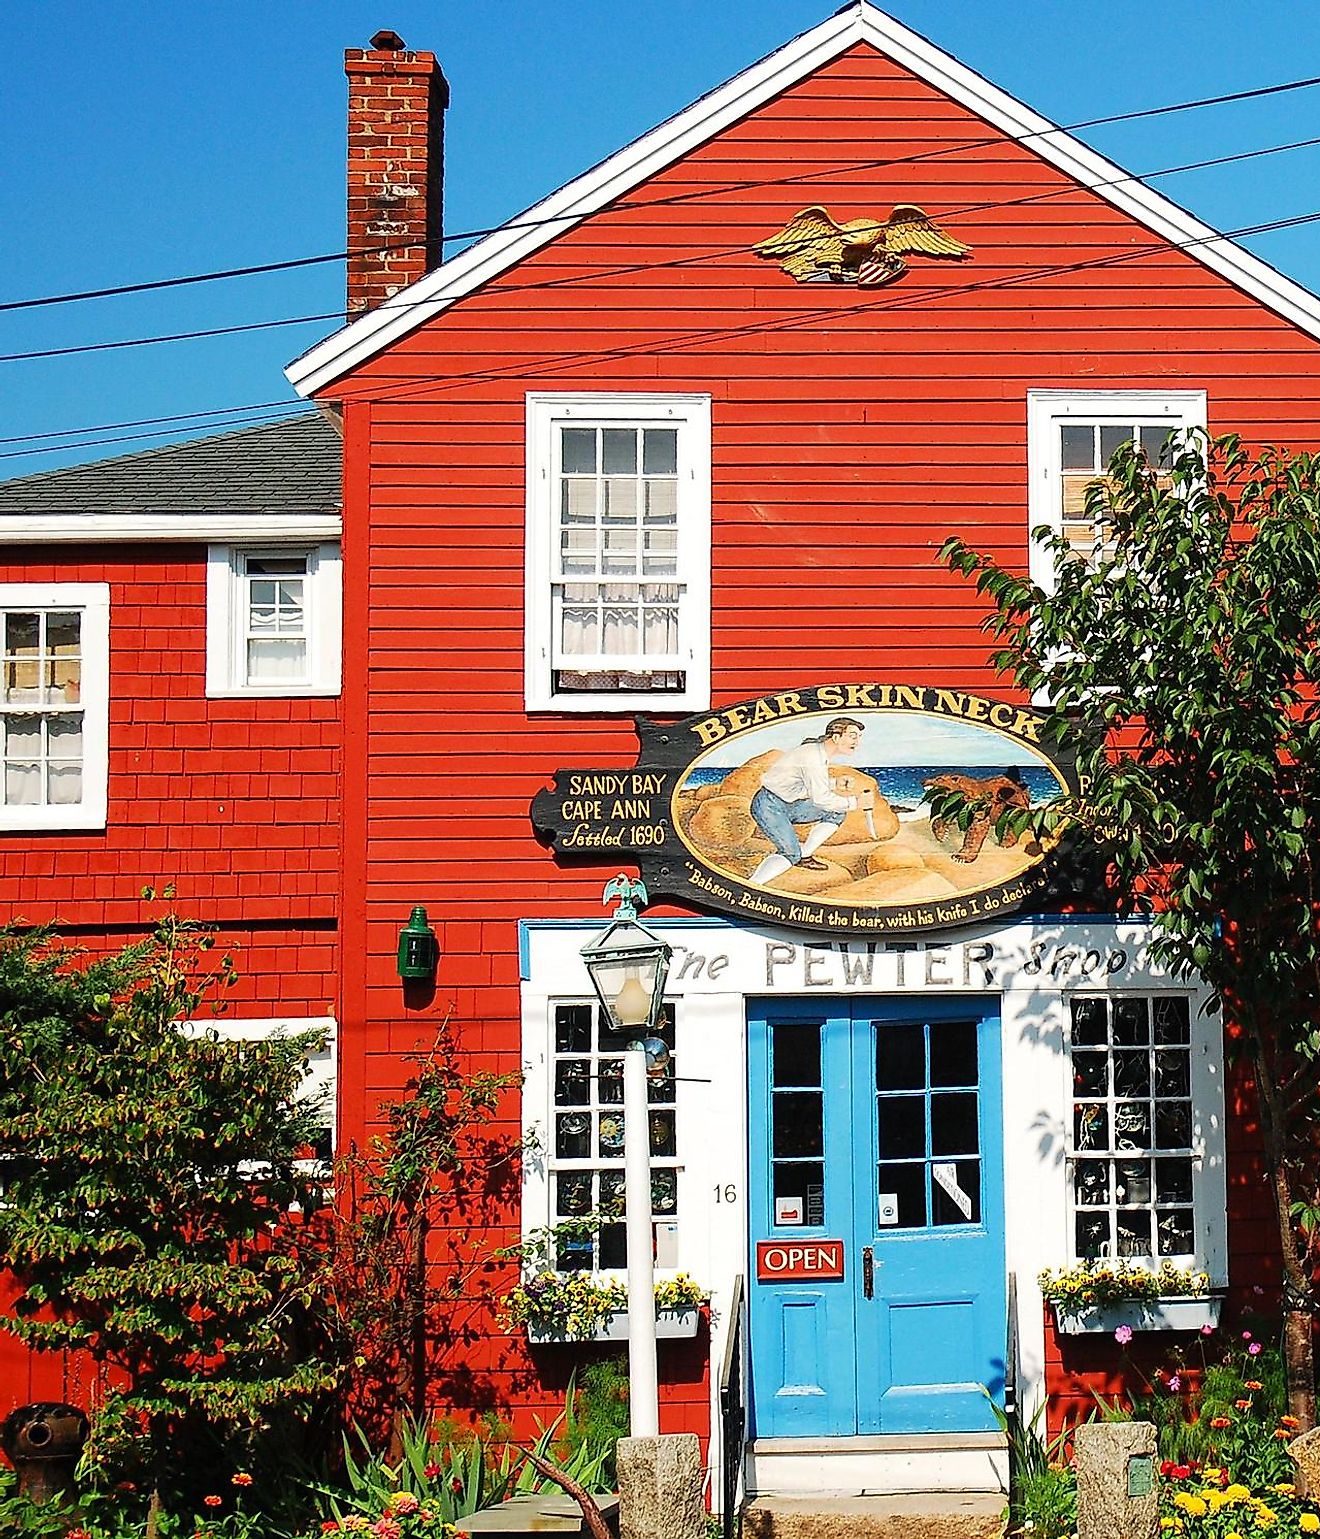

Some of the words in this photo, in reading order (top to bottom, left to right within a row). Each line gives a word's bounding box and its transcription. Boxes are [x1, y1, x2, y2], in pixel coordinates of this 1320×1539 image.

[690, 691, 808, 748] BEAR
[816, 685, 926, 709] SKIN
[934, 689, 1047, 743] NECK
[569, 774, 630, 796] SANDY
[632, 773, 667, 795] BAY
[561, 800, 603, 820] CAPE
[610, 799, 651, 820] ANN
[562, 822, 626, 847] Settled
[629, 825, 665, 846] 1690
[738, 890, 787, 921] Babson,
[827, 912, 849, 926] the
[852, 912, 885, 930] bear,
[886, 909, 916, 928] with
[917, 908, 935, 925] his
[969, 899, 981, 915] I
[984, 895, 1000, 911] do
[765, 941, 998, 987] PEWTER
[1022, 941, 1128, 977] Shop
[713, 1183, 738, 1204] 16
[764, 1247, 838, 1272] OPEN
